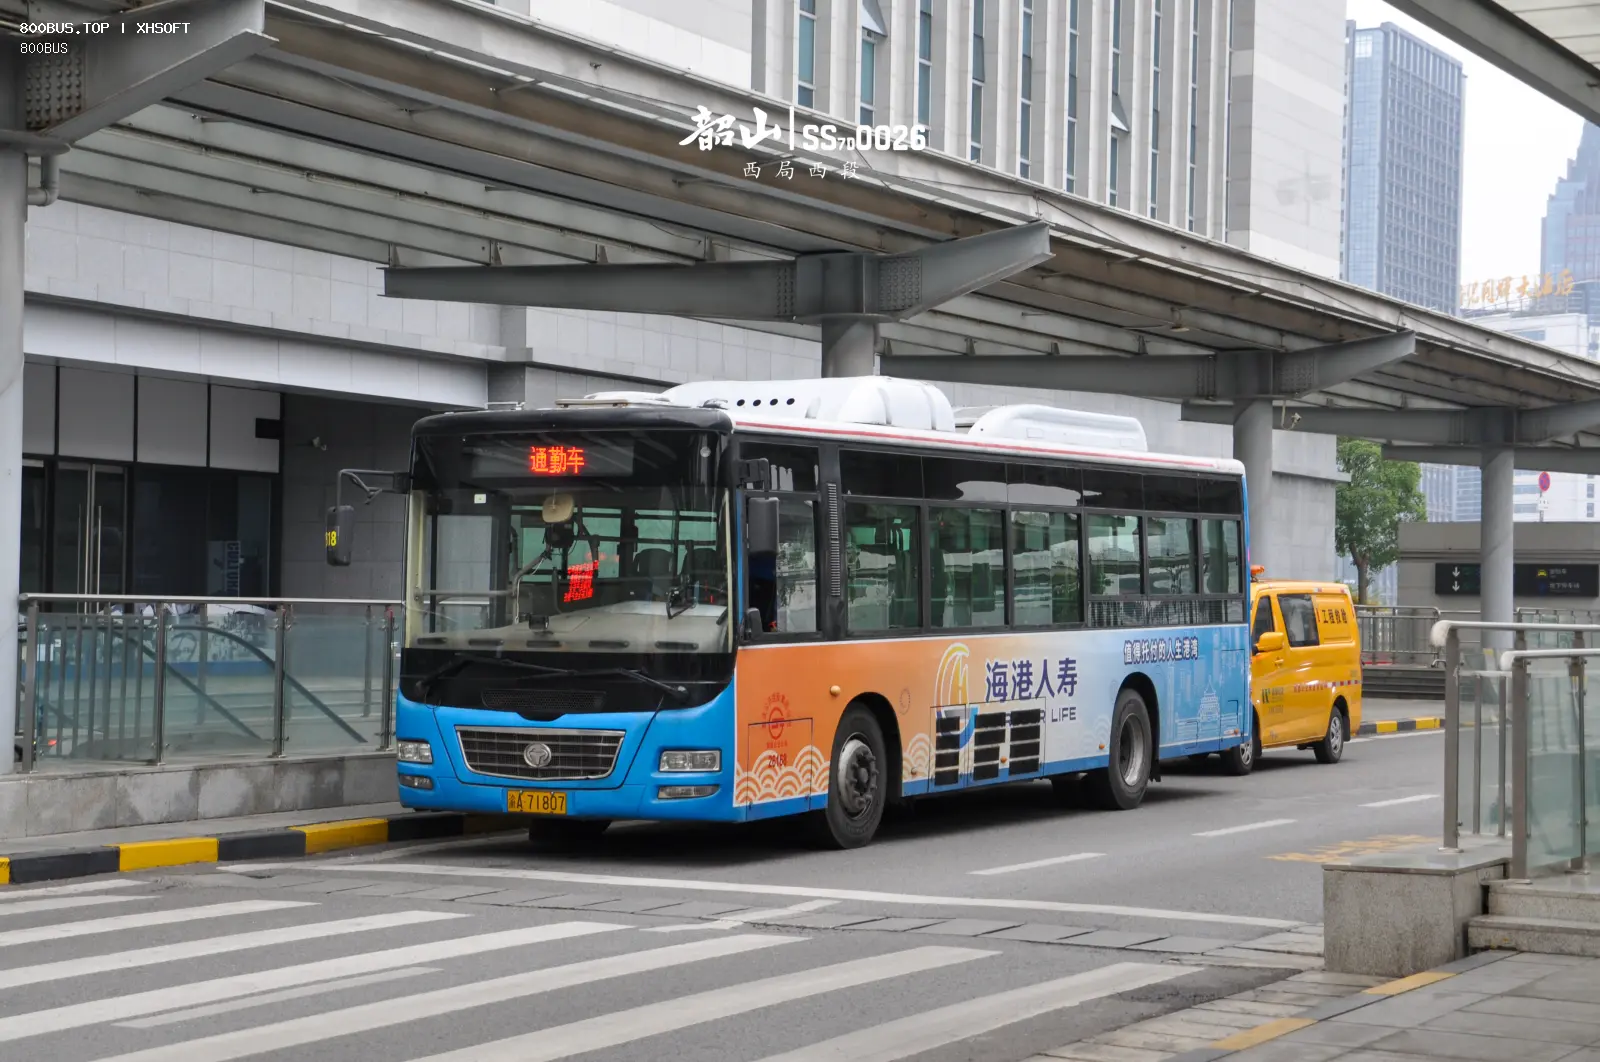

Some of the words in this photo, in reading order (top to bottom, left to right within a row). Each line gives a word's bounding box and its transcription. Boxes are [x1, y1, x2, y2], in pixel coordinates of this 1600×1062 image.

[530, 446, 585, 474] 通勤车
[1124, 636, 1198, 665] 值得托付的人生港湾
[985, 657, 1078, 703] 海港人寿
[1051, 706, 1077, 723] LIFE
